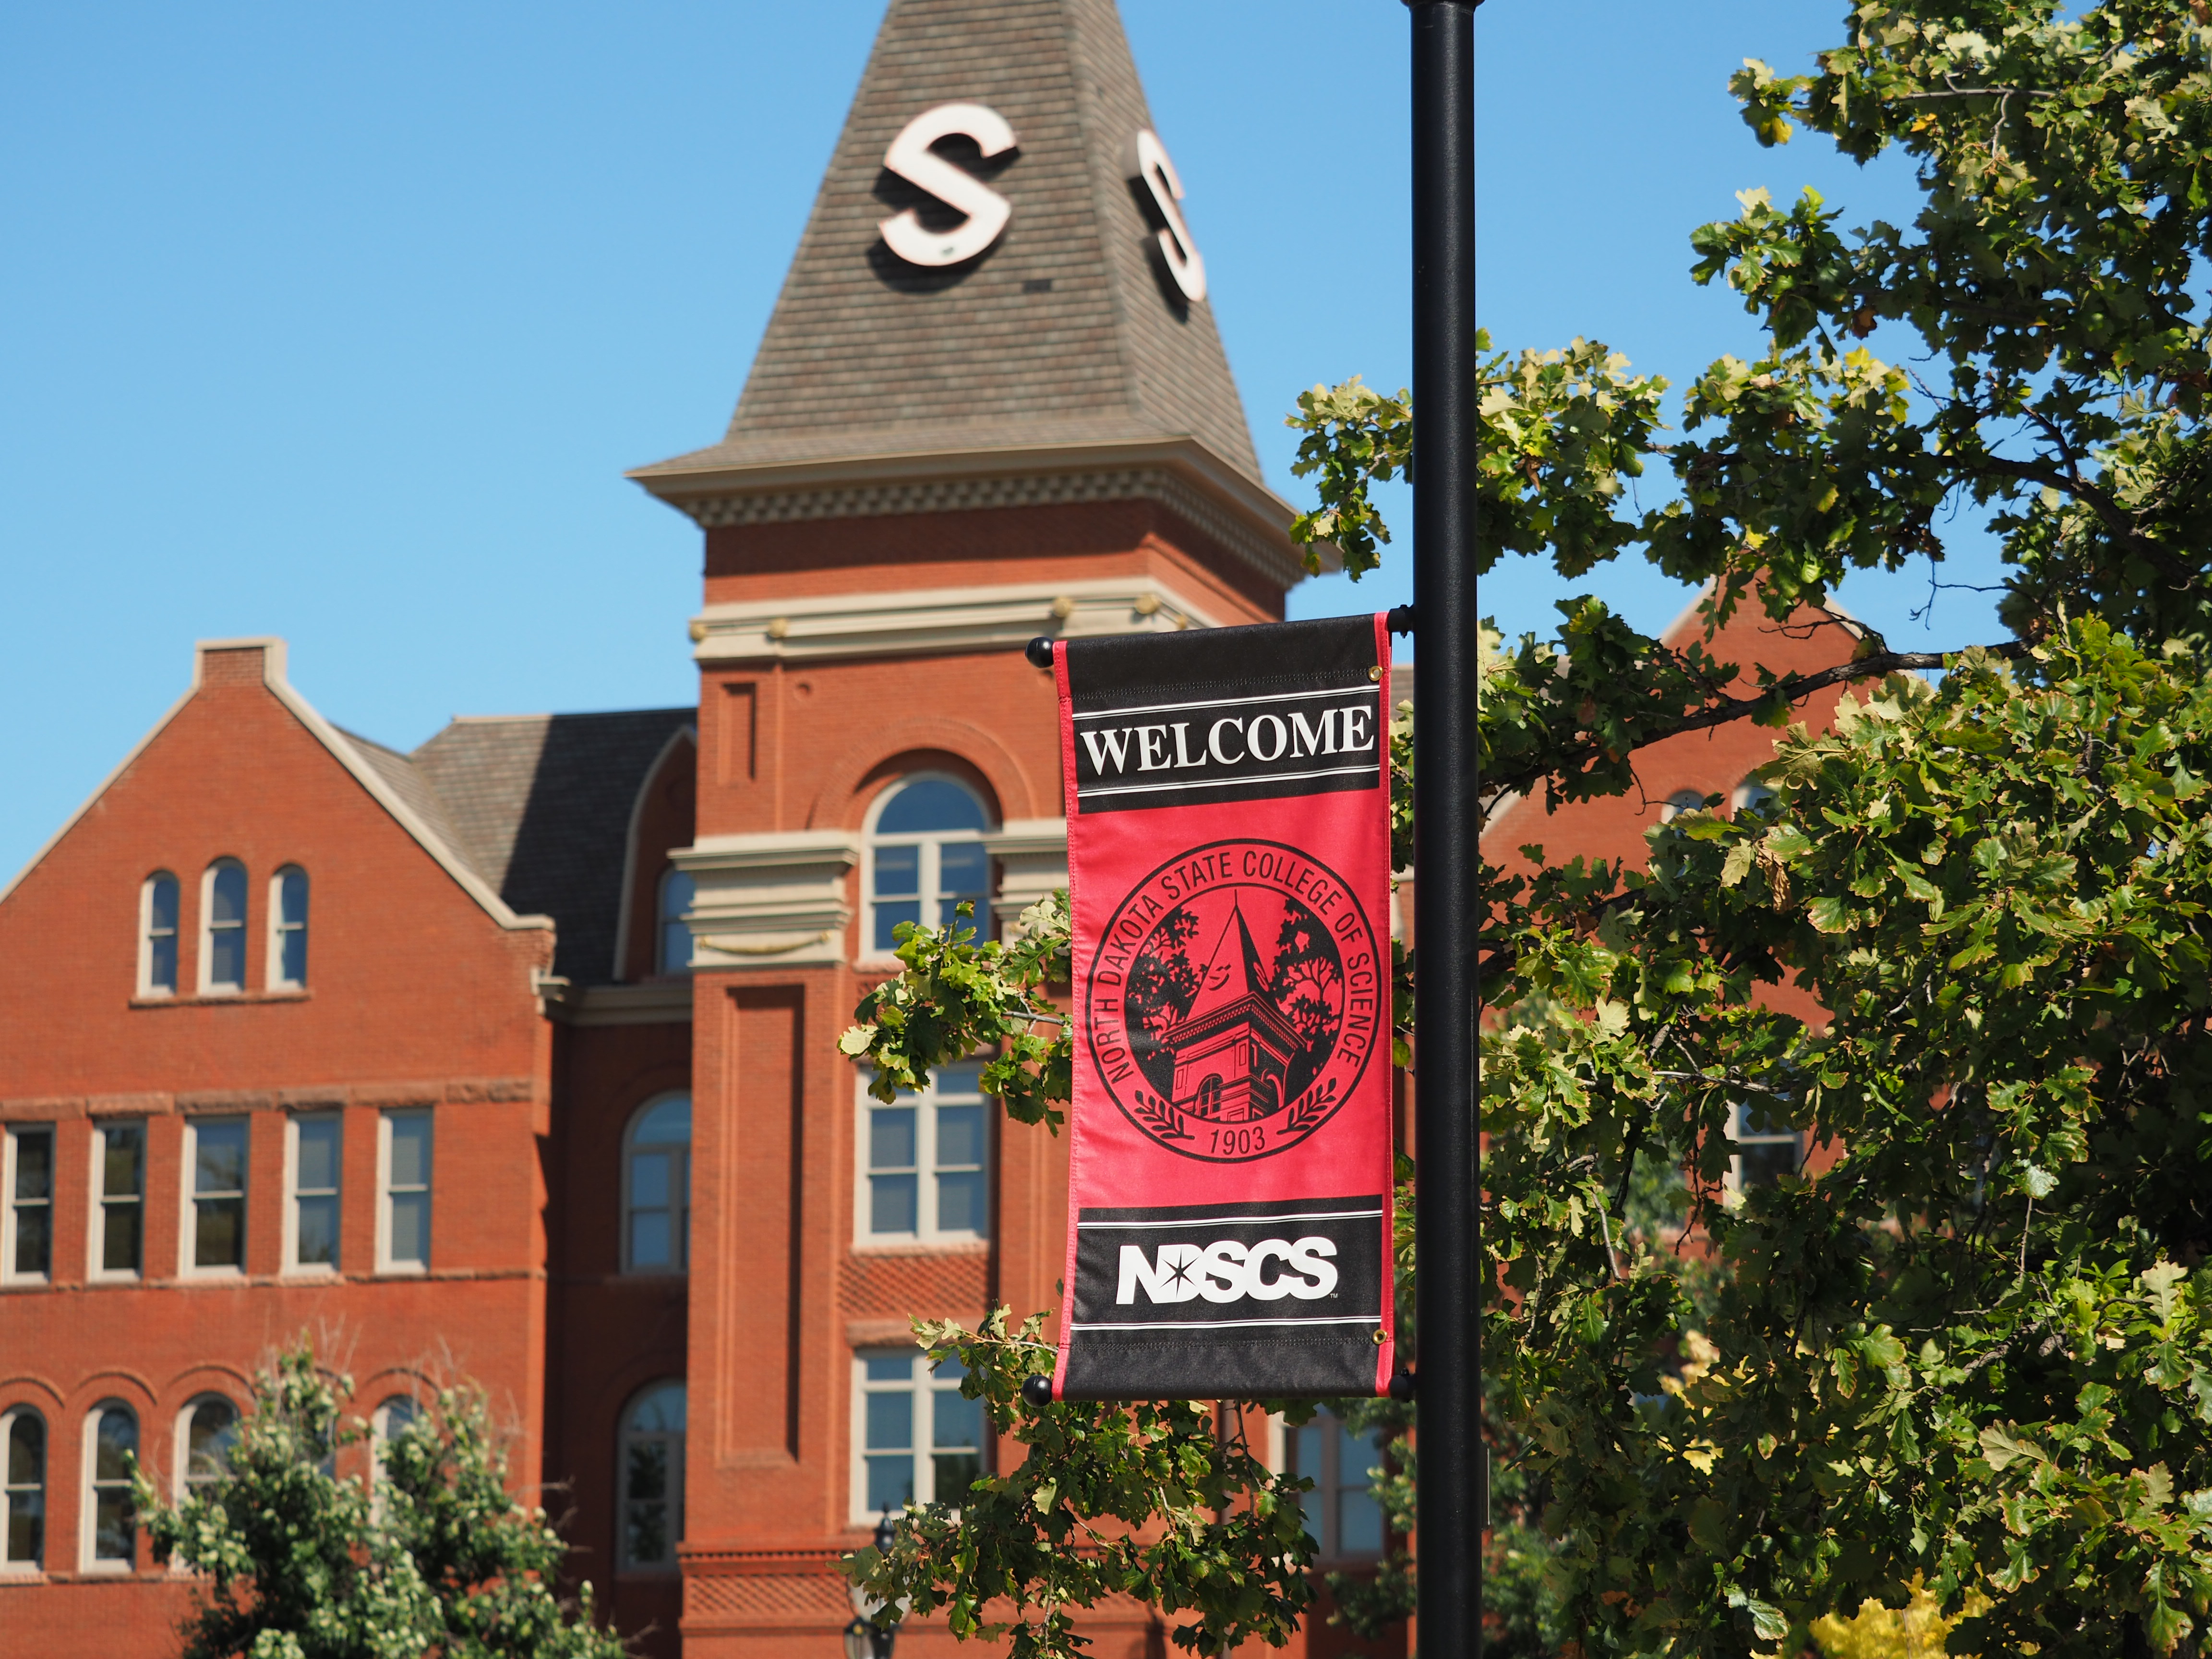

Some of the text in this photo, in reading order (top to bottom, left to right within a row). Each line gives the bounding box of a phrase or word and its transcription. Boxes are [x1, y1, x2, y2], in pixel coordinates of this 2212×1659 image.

[878, 102, 1017, 267] S
[1136, 129, 1206, 302] S
[1080, 705, 1374, 776] WELCOME
[1095, 851, 1374, 1085] NORTH DAKOTA STATE COLLEGE OF SCIENCE
[1210, 1126, 1266, 1154] 1903
[1116, 1237, 1338, 1305] NDSCS
